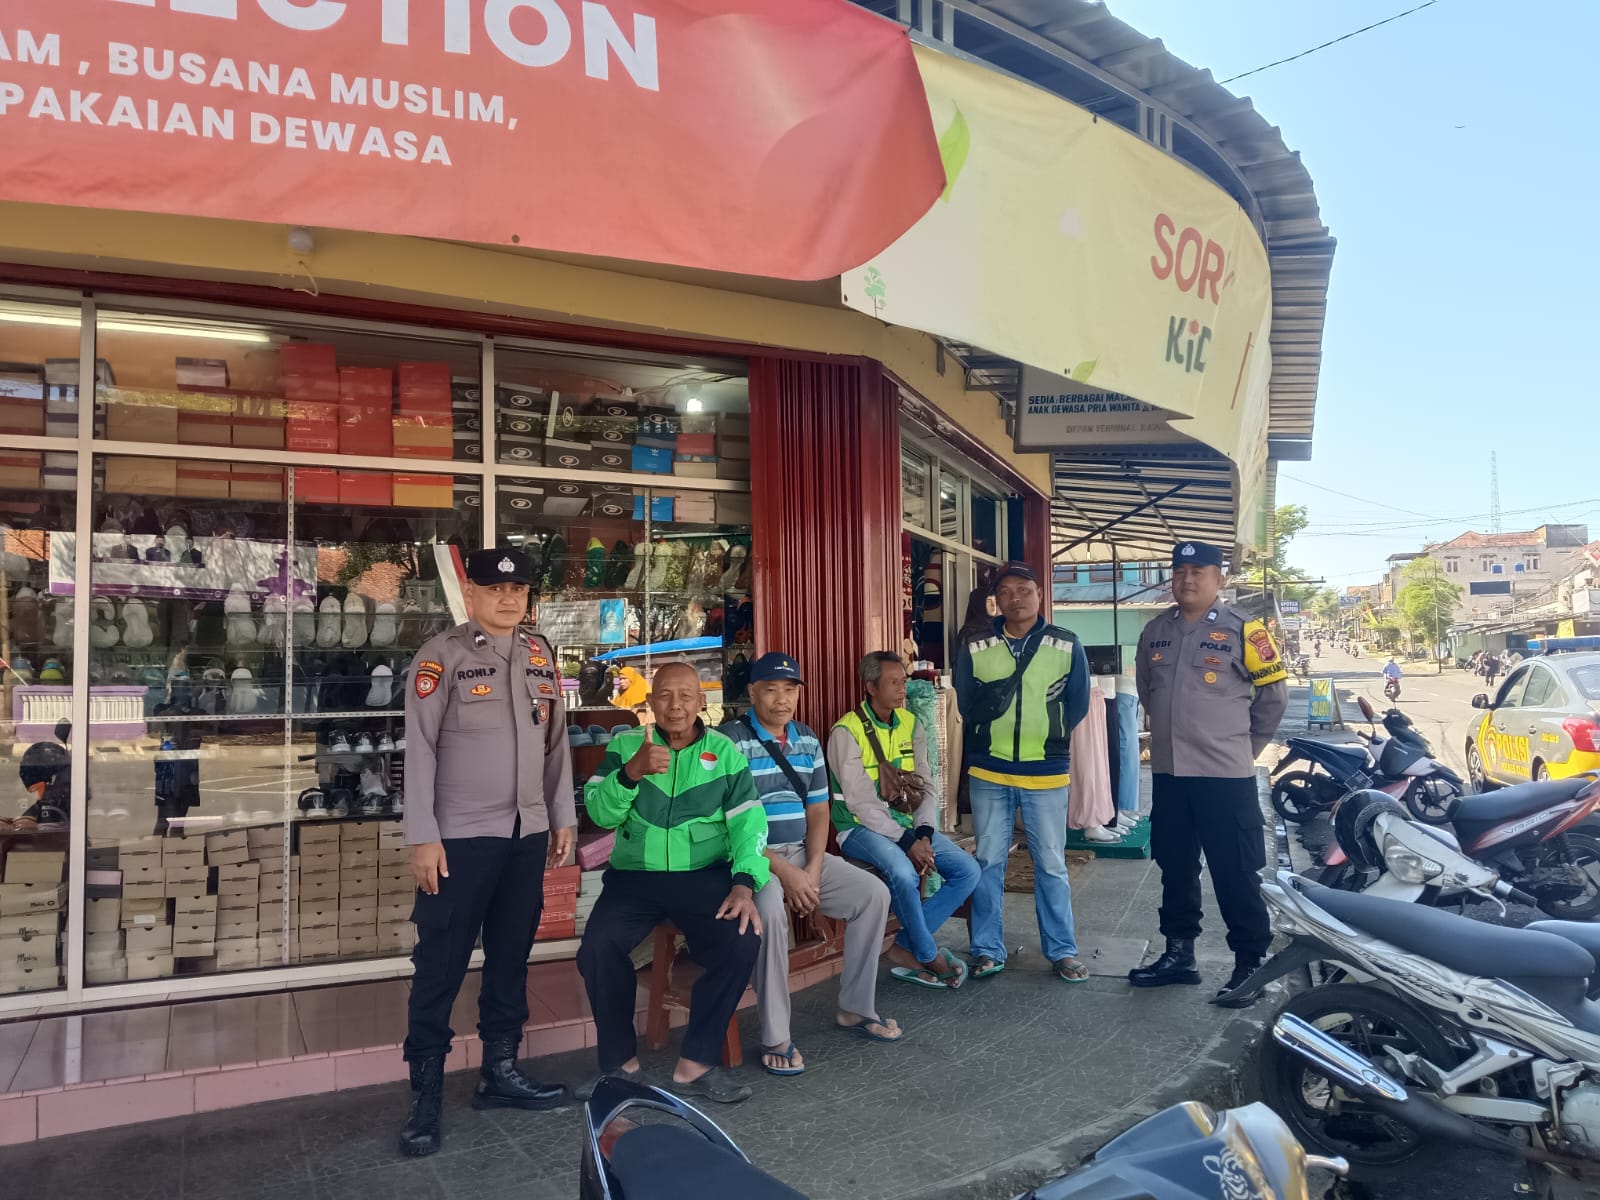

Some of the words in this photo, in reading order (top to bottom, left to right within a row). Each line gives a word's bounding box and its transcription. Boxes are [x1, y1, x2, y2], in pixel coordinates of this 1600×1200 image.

[108, 41, 316, 100] BUSANA
[330, 73, 518, 131] MUSLIM,
[0, 81, 234, 141] PAKAIAN
[250, 112, 452, 166] DEWASA
[1151, 213, 1235, 305] SOR
[1059, 393, 1104, 404] BERBAGAI
[1028, 405, 1049, 414] ANAK
[1052, 404, 1085, 414] DEWASA
[1087, 403, 1107, 413] PRIA
[1109, 402, 1140, 413] WANITA
[1150, 640, 1171, 649] DEDI
[1200, 641, 1233, 653] POLRI
[525, 668, 555, 681] POLRI
[1496, 733, 1529, 763] POLISI
